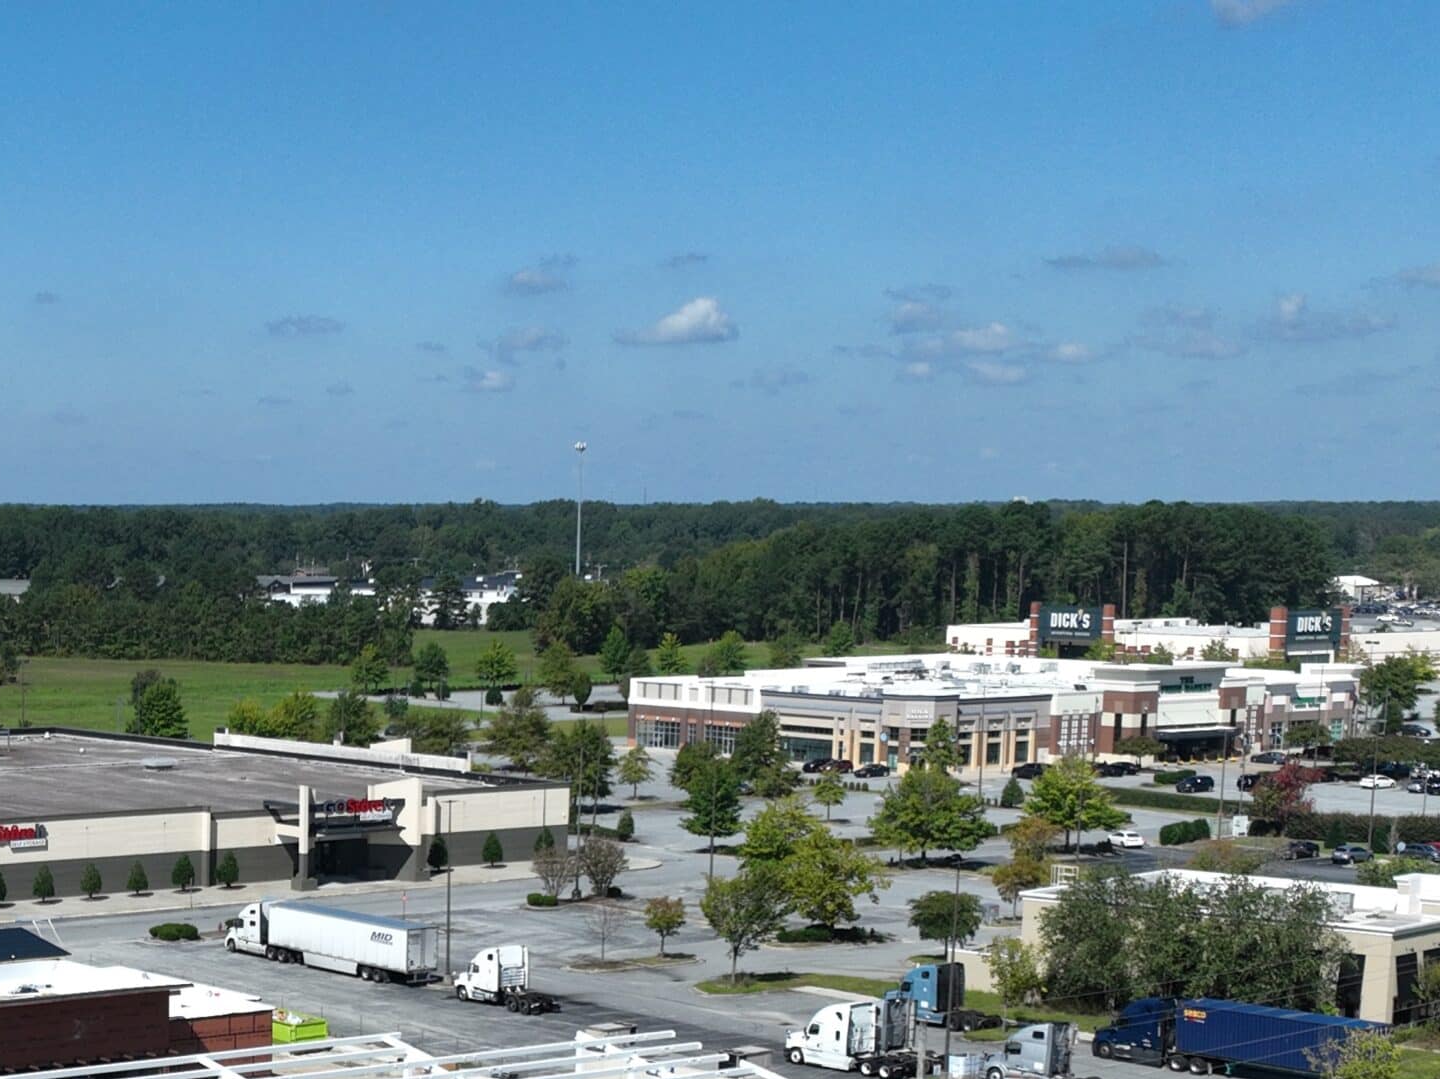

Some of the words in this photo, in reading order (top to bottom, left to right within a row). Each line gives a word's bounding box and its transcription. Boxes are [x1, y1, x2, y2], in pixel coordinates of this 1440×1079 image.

[1050, 609, 1091, 629] DICK'S
[1296, 611, 1333, 633] DICK'S
[370, 931, 393, 941] MID
